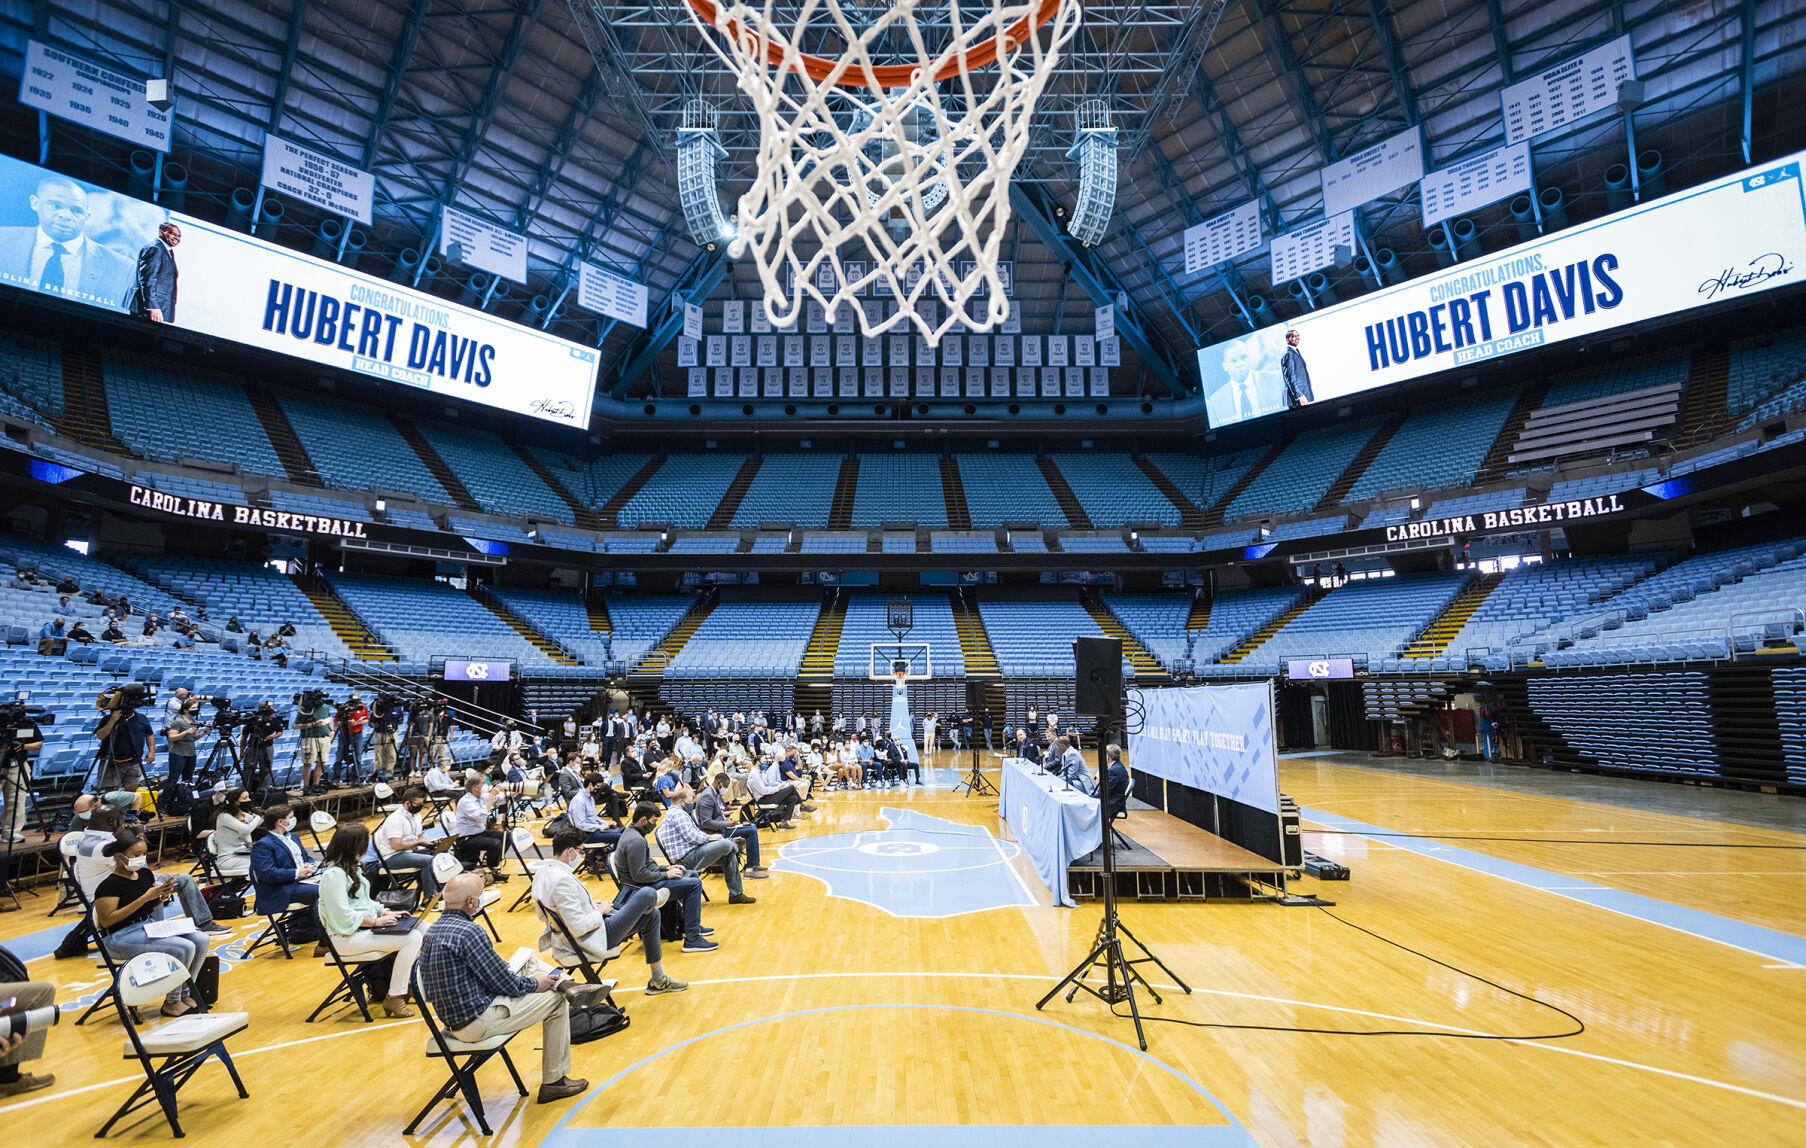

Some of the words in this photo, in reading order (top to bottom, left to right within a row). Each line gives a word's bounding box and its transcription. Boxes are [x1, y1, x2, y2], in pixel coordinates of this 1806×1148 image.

[32, 67, 54, 81] 1922
[72, 82, 93, 95] 1924
[110, 96, 131, 109] 1925
[43, 48, 99, 75] SOUTHERN
[99, 69, 147, 94] CONFERE
[29, 86, 52, 100] 1935
[108, 114, 129, 127] 1940
[145, 127, 165, 140] 1945
[285, 144, 298, 156] THE
[300, 149, 330, 167] PERFECT
[331, 163, 358, 178] SEASON
[299, 167, 343, 187] UNDEFEATED
[277, 181, 302, 196] COACH
[304, 192, 326, 205] FRANK
[280, 167, 315, 185] NATIONAL
[316, 181, 357, 200] CHAMPIONS
[0, 271, 38, 287] OLINA
[44, 283, 115, 306] BASKETBALL
[1365, 290, 1493, 371] HUBERT
[1502, 253, 1624, 335] DAVIS
[262, 279, 403, 363] HUBERT
[407, 322, 496, 389] DAVIS
[1457, 345, 1493, 363] HEAD
[1496, 333, 1541, 355] COACH
[354, 356, 389, 377] HEAD
[391, 366, 429, 386] COACH
[130, 485, 224, 521] CAROLINA
[233, 506, 367, 539] BASKETBALL
[1386, 516, 1476, 542] CAROLINA
[1484, 494, 1624, 529] BASKETBALL
[1209, 731, 1248, 753] TOGETHER.
